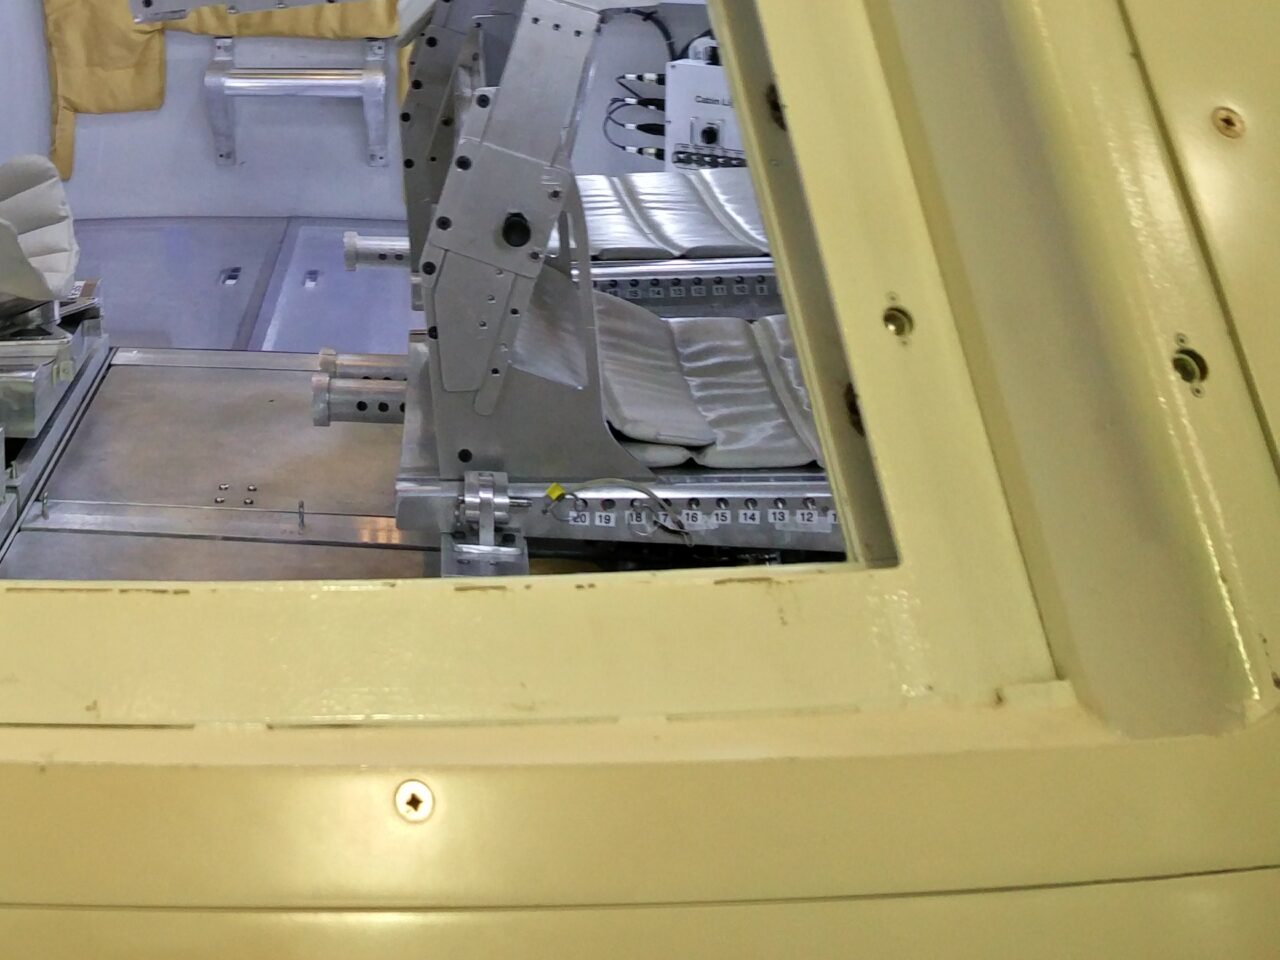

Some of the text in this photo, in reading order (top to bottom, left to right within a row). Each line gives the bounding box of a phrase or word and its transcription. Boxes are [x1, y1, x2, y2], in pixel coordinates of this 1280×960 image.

[695, 95, 720, 106] Cabin
[572, 513, 587, 524] 20
[599, 514, 612, 525] 19
[629, 512, 643, 523] 18
[684, 512, 699, 523] 16
[714, 512, 728, 522] 15
[742, 512, 757, 522] 14
[771, 511, 786, 522] 13
[800, 512, 814, 522] 12
